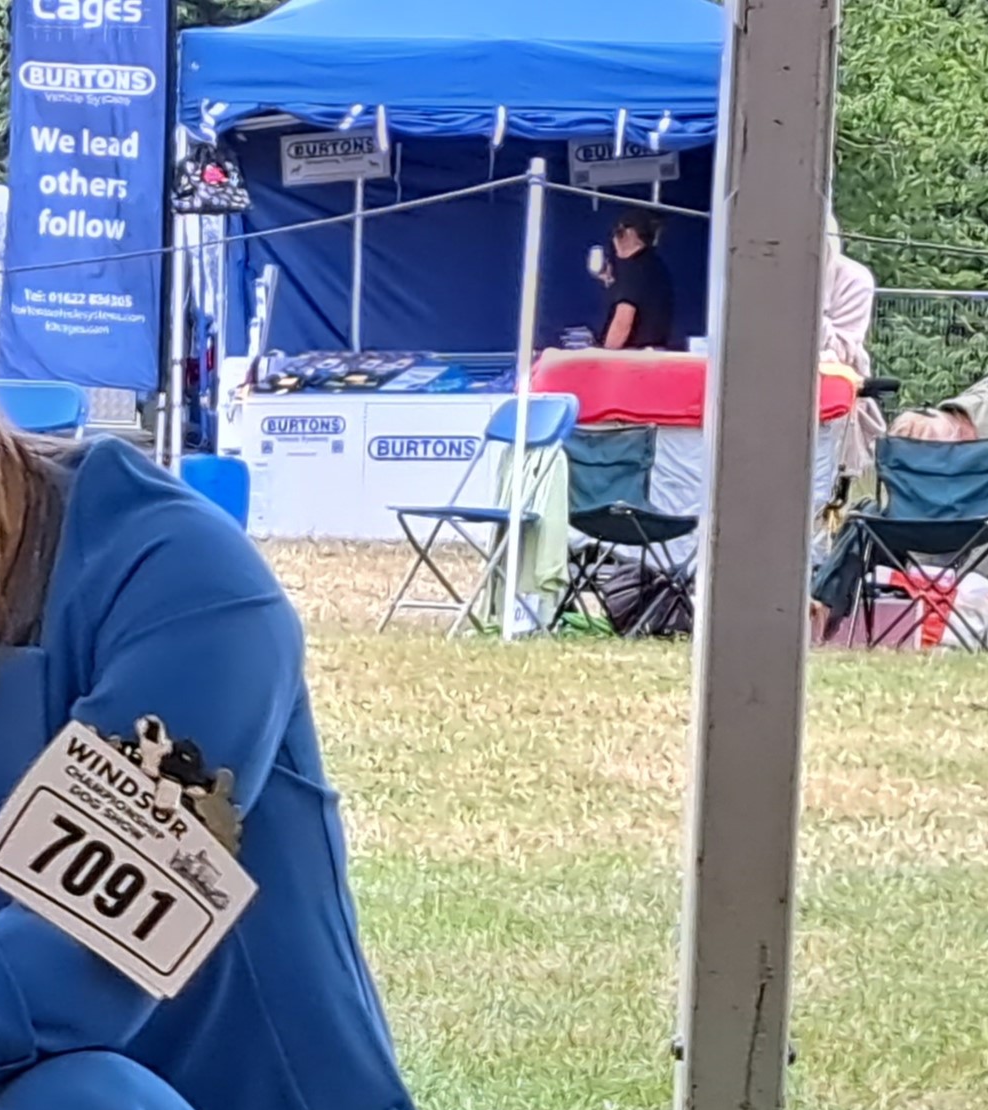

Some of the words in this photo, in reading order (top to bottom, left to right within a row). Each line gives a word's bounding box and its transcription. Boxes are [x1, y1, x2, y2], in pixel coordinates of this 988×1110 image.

[32, 0, 143, 28] Cages
[29, 66, 148, 90] BURTONS
[30, 126, 75, 153] We
[82, 128, 139, 158] lead
[39, 168, 128, 198] others
[39, 208, 126, 241] follow
[267, 418, 341, 432] BURTONS
[376, 439, 476, 457] BURTONS
[67, 736, 189, 840] WINDSOR
[70, 783, 101, 810] DOG
[101, 807, 145, 841] SHOW
[29, 813, 177, 941] 7091
